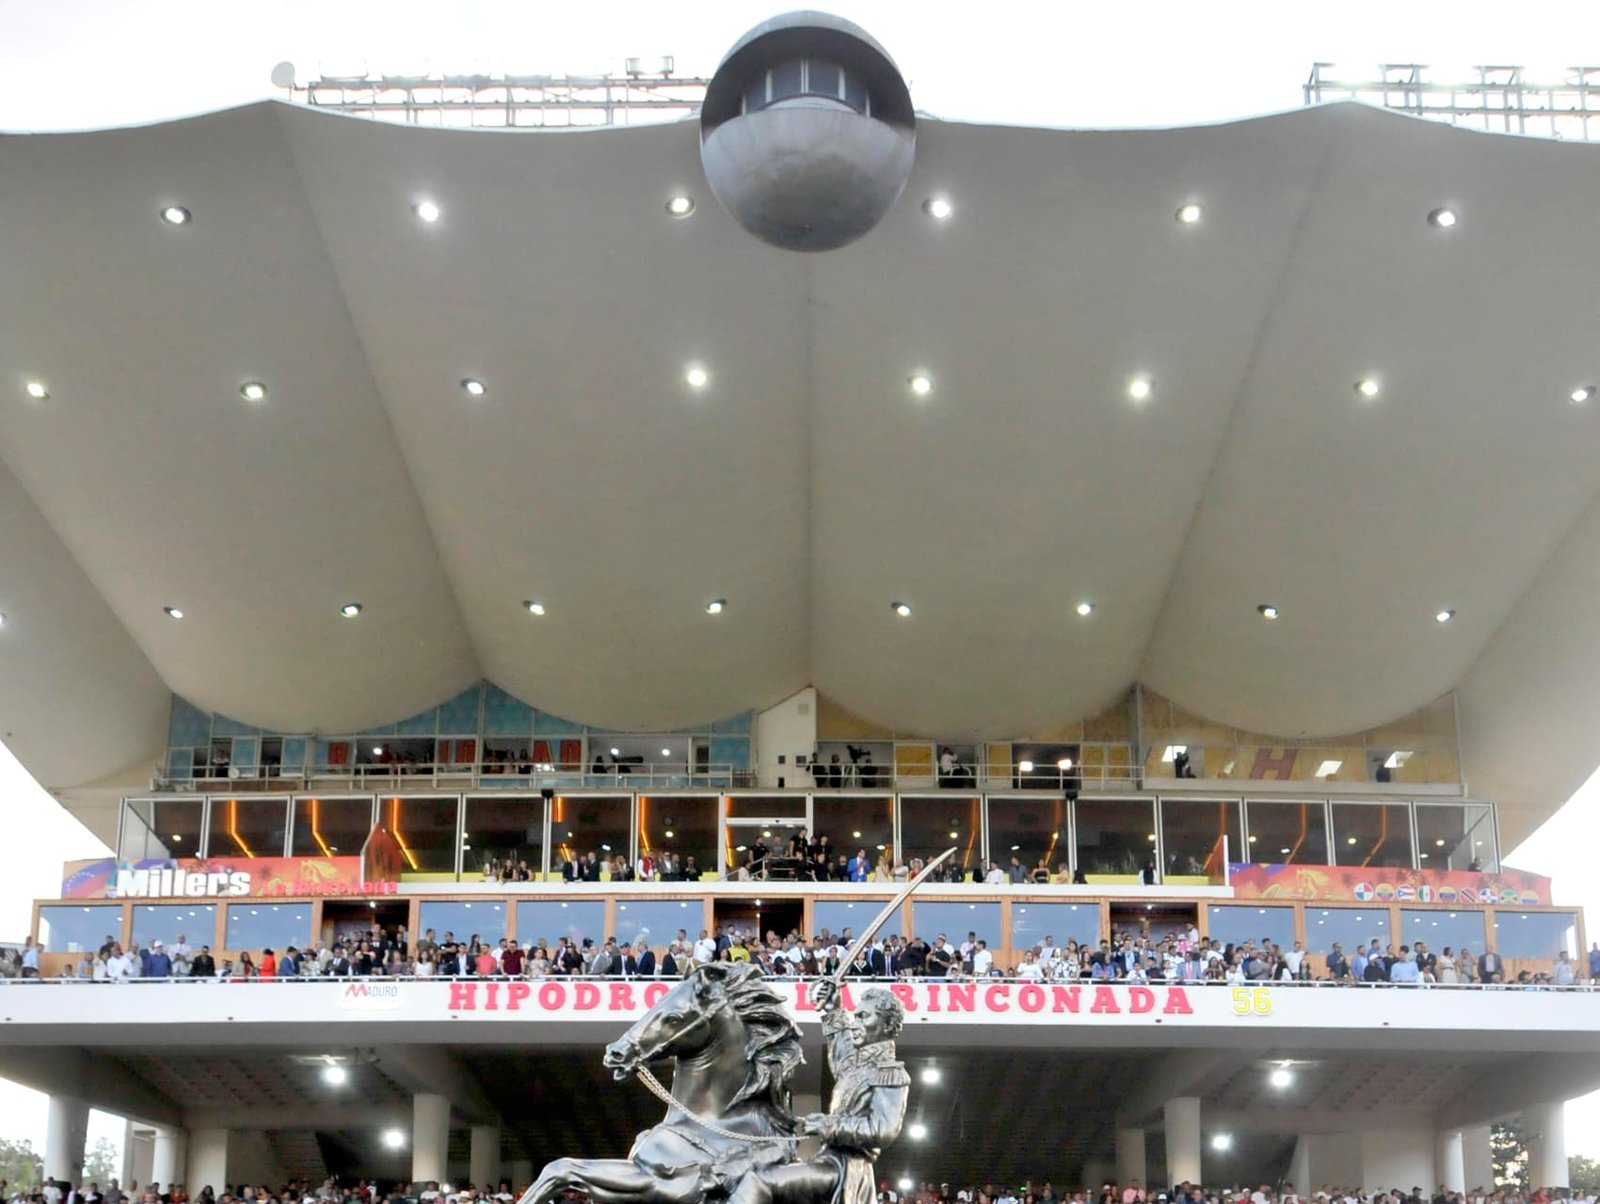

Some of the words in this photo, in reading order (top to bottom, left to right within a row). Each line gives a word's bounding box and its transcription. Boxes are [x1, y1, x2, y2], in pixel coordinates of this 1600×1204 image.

[345, 983, 398, 998] MADURO
[448, 983, 671, 1010] HIPODRO
[890, 984, 1194, 1014] RINCONADA
[1231, 986, 1272, 1014] 56
